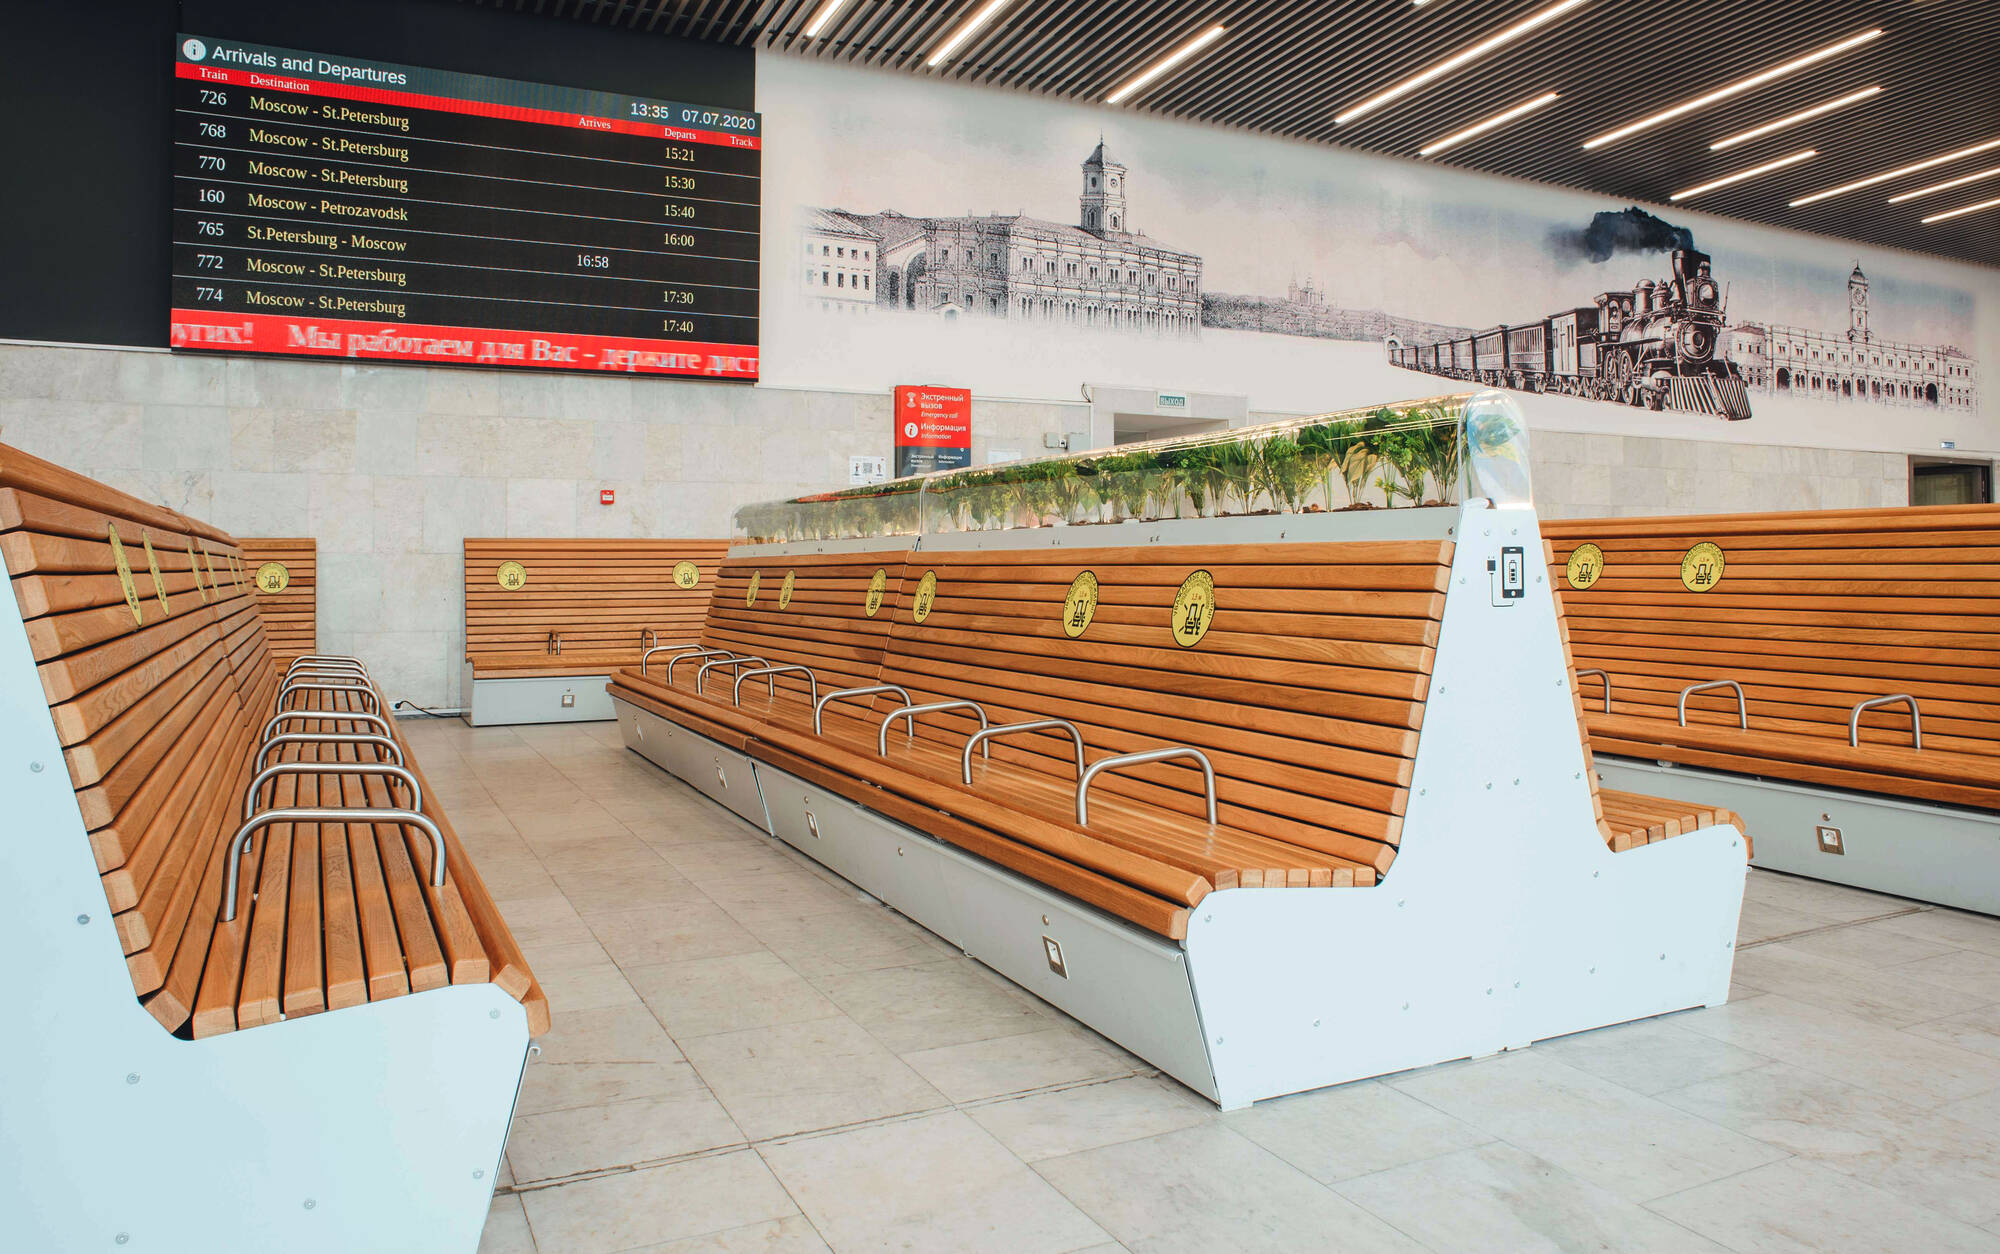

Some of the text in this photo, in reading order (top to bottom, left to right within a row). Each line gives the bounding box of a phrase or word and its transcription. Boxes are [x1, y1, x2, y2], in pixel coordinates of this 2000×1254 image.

[200, 68, 310, 92] Train Destination
[212, 46, 407, 85] Arrivals and Departures
[200, 90, 227, 106] 726
[250, 96, 308, 116] Moscow
[322, 105, 410, 132] St.Petersburg
[665, 147, 695, 162] 15:21
[578, 117, 753, 147] Arrives Departs Track
[631, 103, 756, 130] 13:35 07.07.2020
[200, 123, 226, 138] 768
[250, 128, 308, 148] Moscow
[322, 137, 409, 162] St.Petersburg
[664, 176, 695, 190] 15:30
[199, 156, 226, 171] 770
[249, 160, 308, 180] Moscow
[321, 168, 408, 193] St.Petersburg
[664, 204, 695, 218] 15:40
[200, 188, 225, 204] 160
[248, 193, 306, 212] Moscow
[320, 200, 408, 221] Petrozavodsk
[664, 233, 694, 247] 16:00
[198, 221, 224, 236] 765
[248, 226, 338, 249] St.Petersburg
[351, 235, 407, 252] Moscow
[577, 254, 609, 268] 16:58
[197, 254, 224, 270] 772
[246, 258, 306, 276] Moscow
[319, 263, 407, 287] St.Petersburg
[663, 290, 694, 304] 17:30
[196, 287, 224, 302] 774
[246, 290, 305, 308] Moscow
[318, 296, 406, 318] St.Petersburg
[663, 320, 694, 333] 17:40
[288, 324, 341, 350] Мы
[477, 341, 525, 362] для
[531, 340, 578, 362] Вас
[920, 392, 964, 402] Экстренный
[1160, 396, 1184, 406] ВЫХОД
[920, 423, 966, 432] Информация
